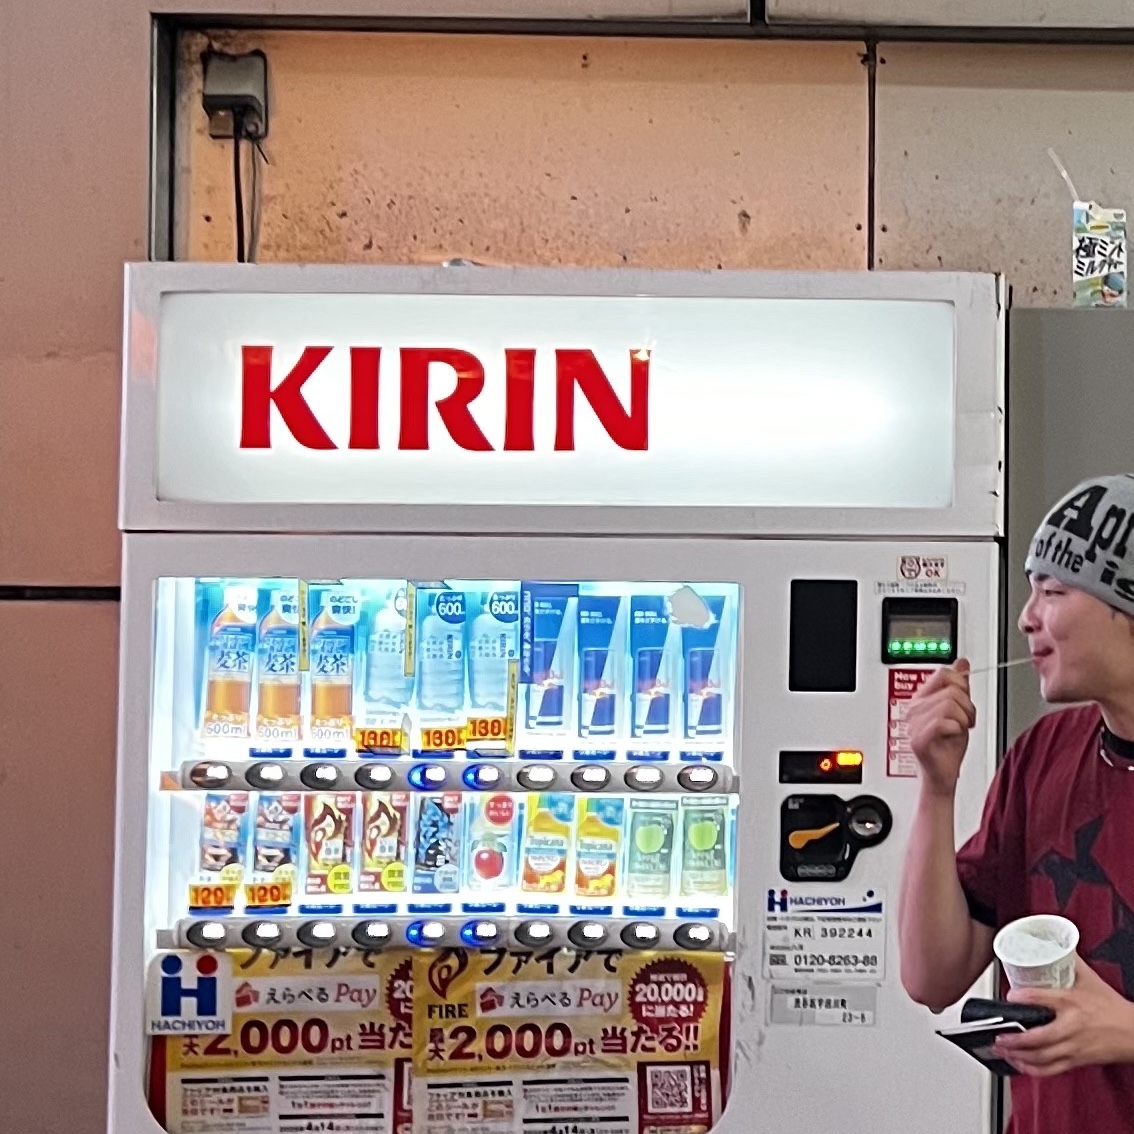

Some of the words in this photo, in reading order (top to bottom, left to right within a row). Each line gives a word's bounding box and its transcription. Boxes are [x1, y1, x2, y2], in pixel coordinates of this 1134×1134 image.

[240, 344, 652, 452] KIRIN
[1035, 531, 1057, 558] of
[1051, 537, 1084, 574] the
[789, 896, 846, 906] HACHIYOH
[794, 928, 812, 938] KR
[820, 927, 873, 938] 392244
[265, 986, 330, 1005] えらべる
[335, 983, 377, 1008] Pay
[508, 992, 573, 1009] えらべる
[577, 987, 620, 1013] Pay
[428, 1003, 469, 1019] FIRE
[151, 1020, 226, 1032] HACHIYOH
